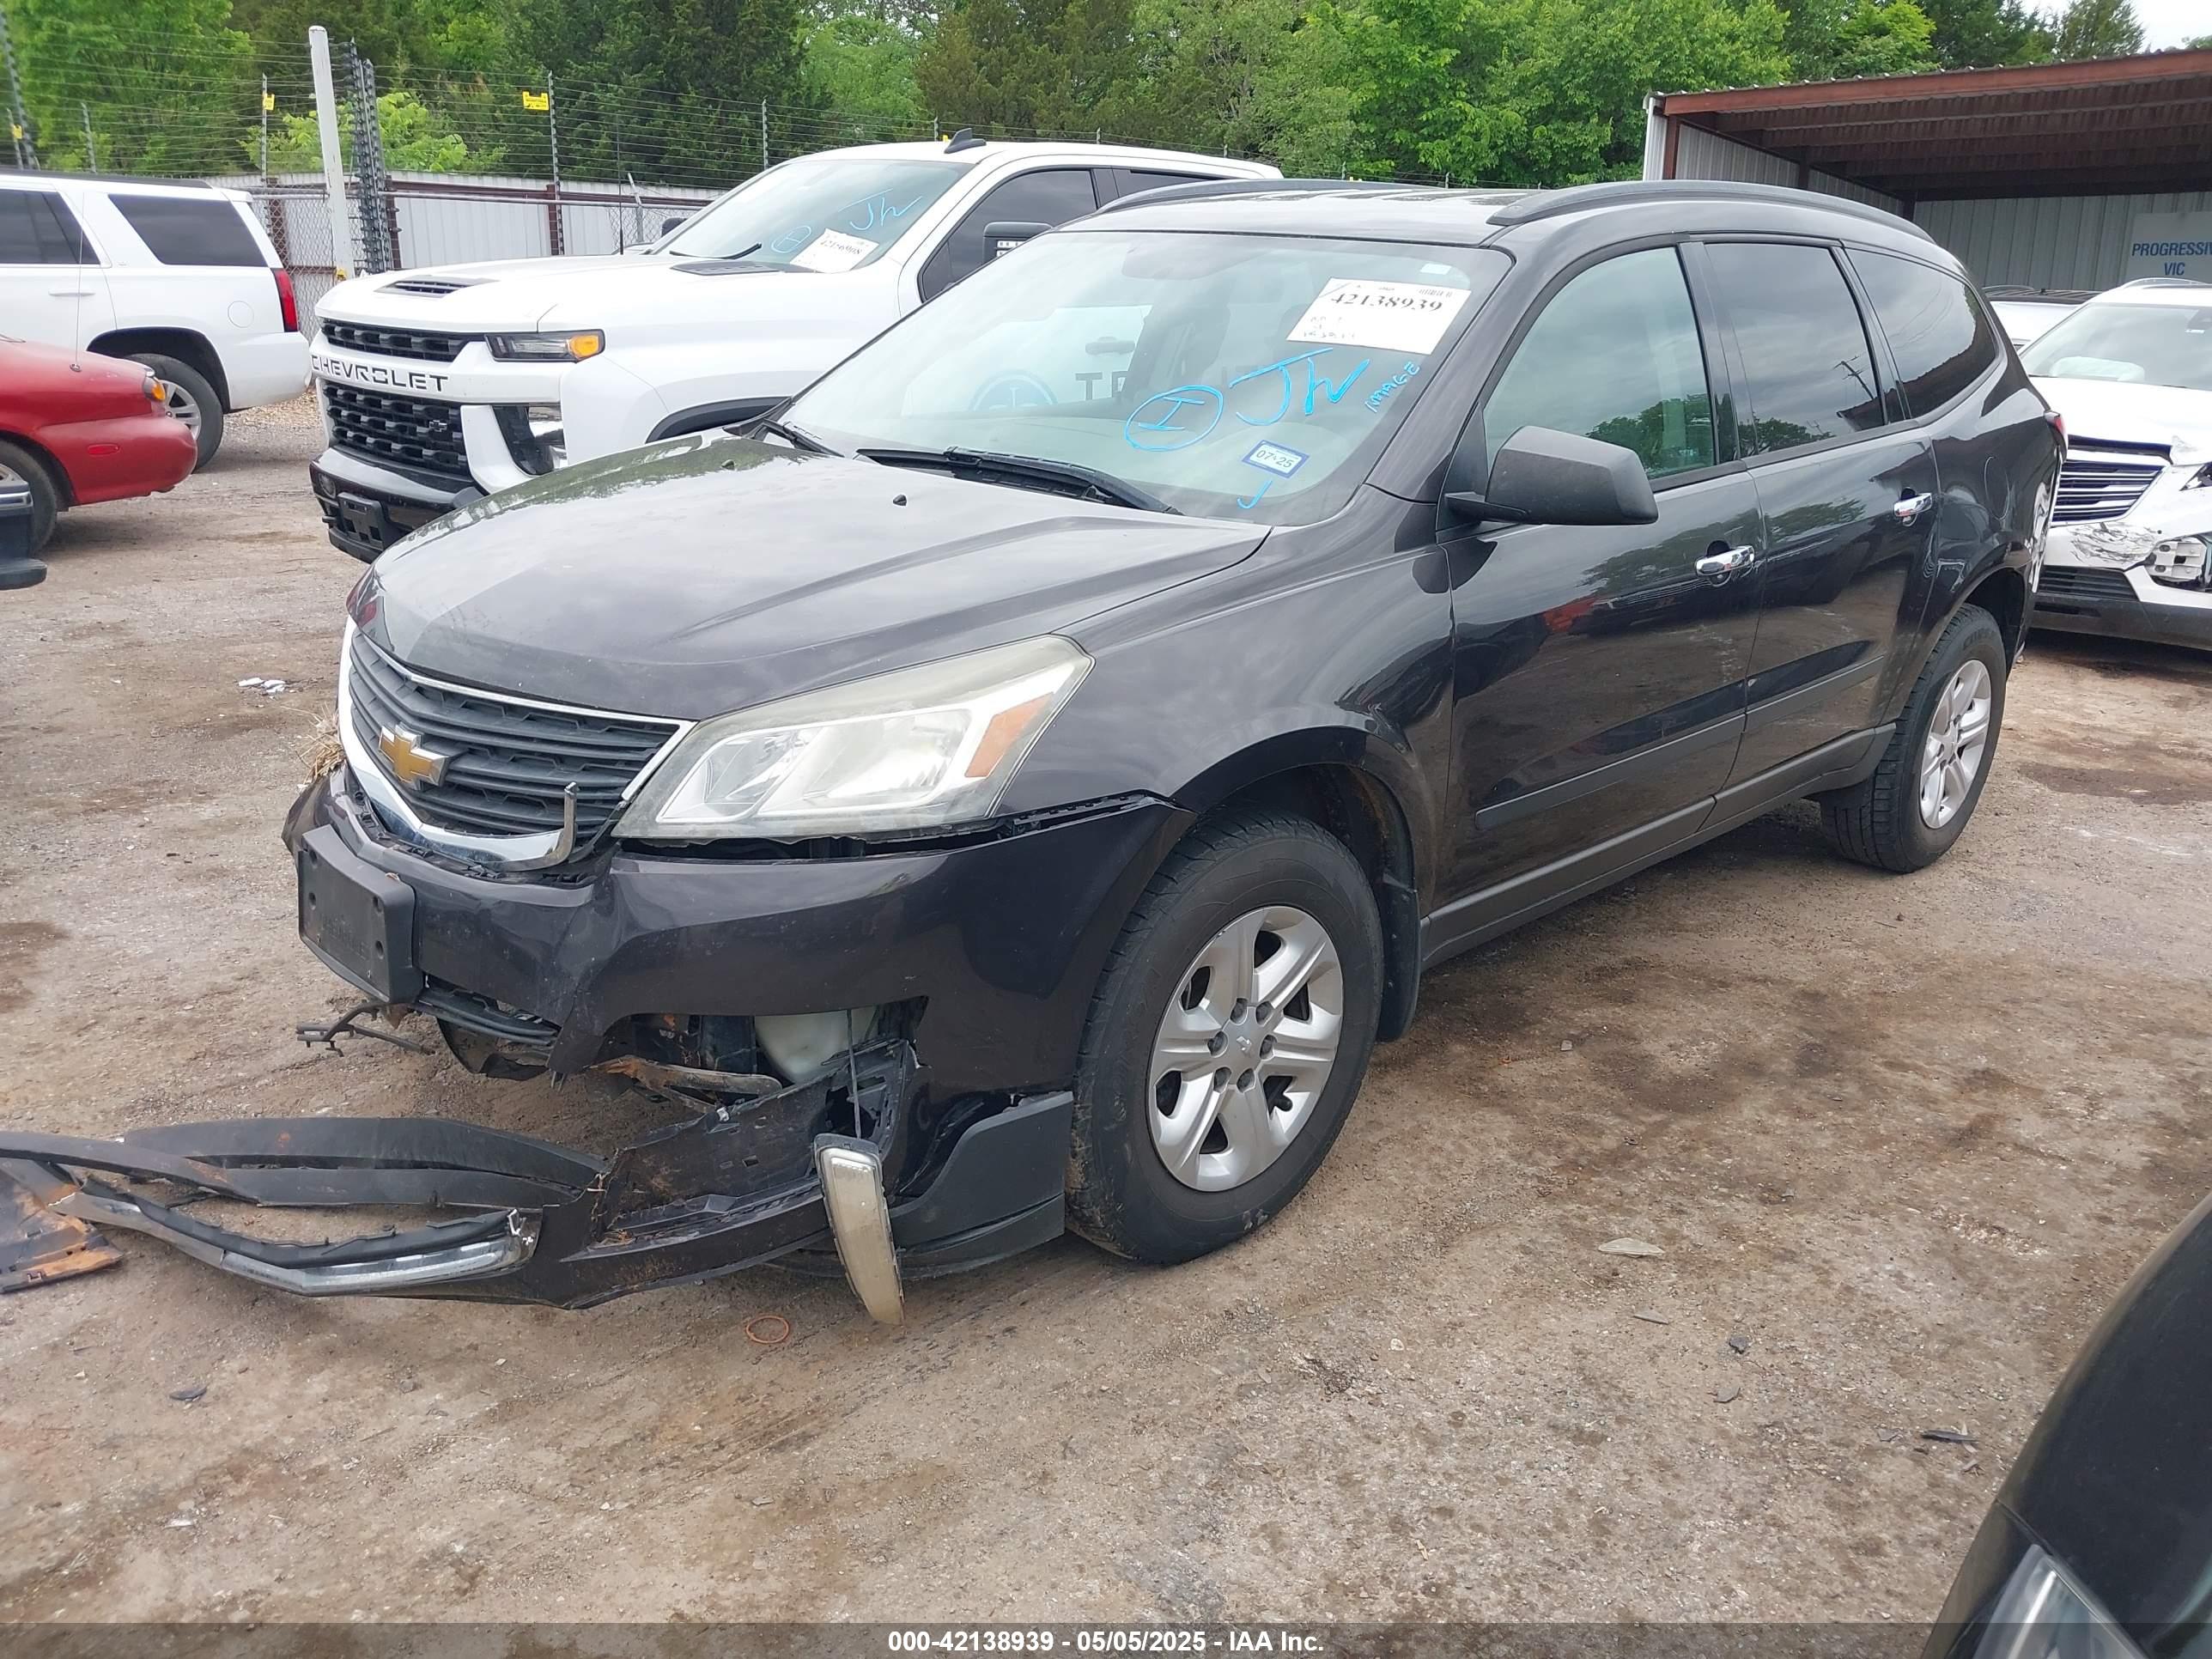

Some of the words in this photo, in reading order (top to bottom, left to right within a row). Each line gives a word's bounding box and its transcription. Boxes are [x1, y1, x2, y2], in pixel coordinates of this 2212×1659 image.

[2164, 262, 2185, 276] VIC
[1330, 293, 1443, 313] 42138939
[311, 354, 448, 392] CHEVROLET
